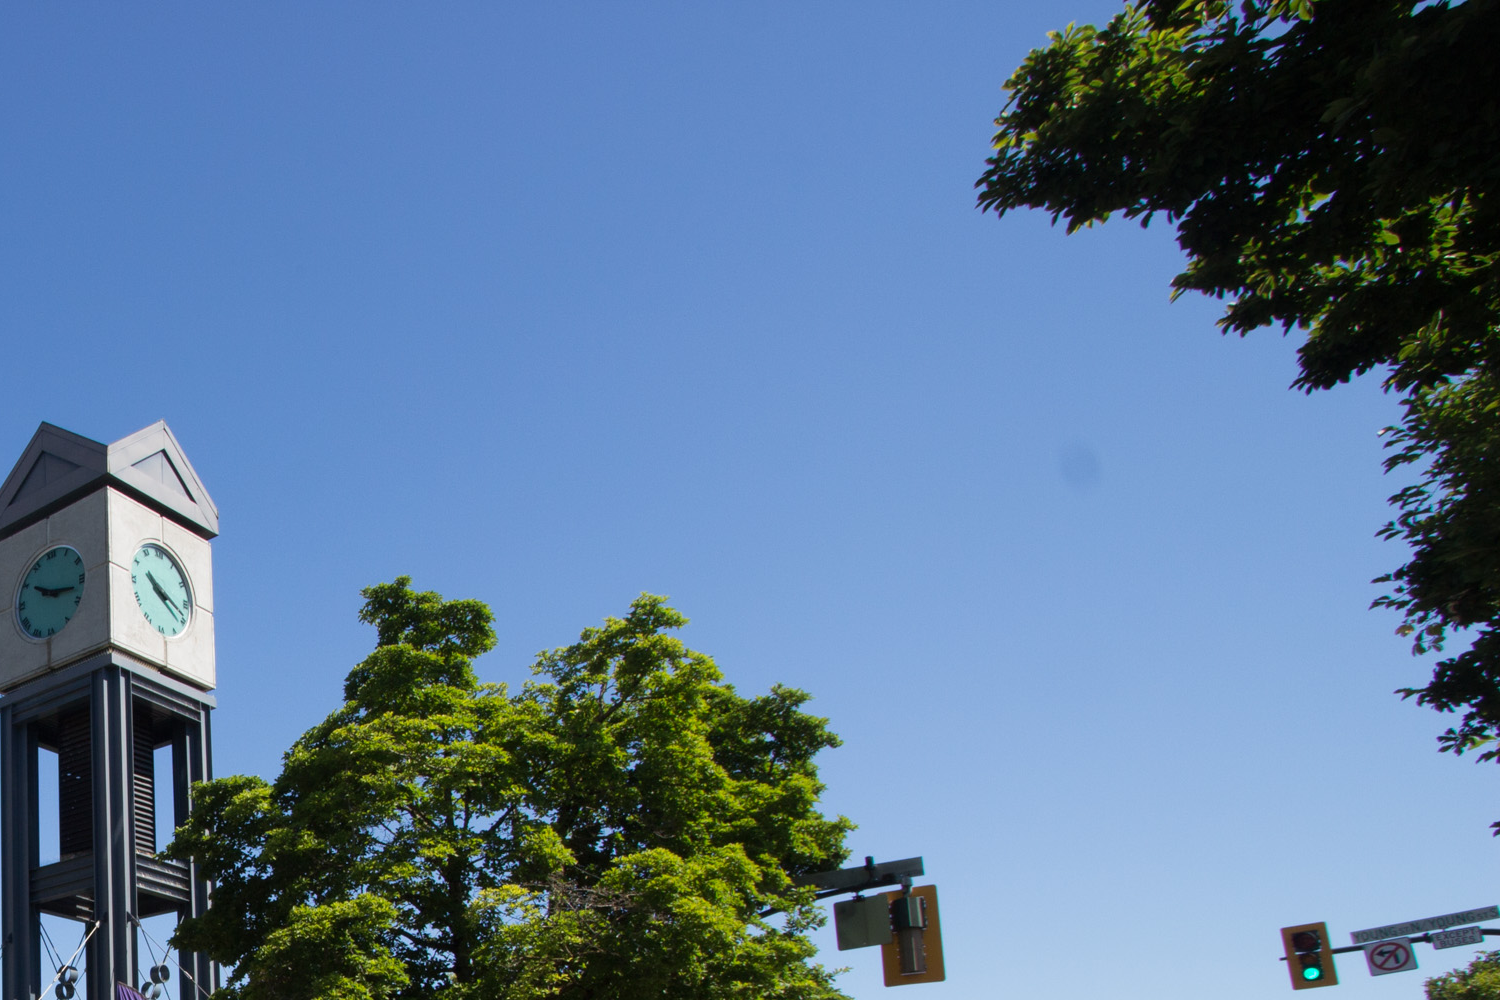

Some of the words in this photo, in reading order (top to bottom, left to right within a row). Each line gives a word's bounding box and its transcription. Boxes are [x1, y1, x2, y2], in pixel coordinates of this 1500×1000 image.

[1353, 925, 1396, 942] YOUNG
[1435, 928, 1477, 941] EXCEPT
[1439, 935, 1476, 948] BUSES
